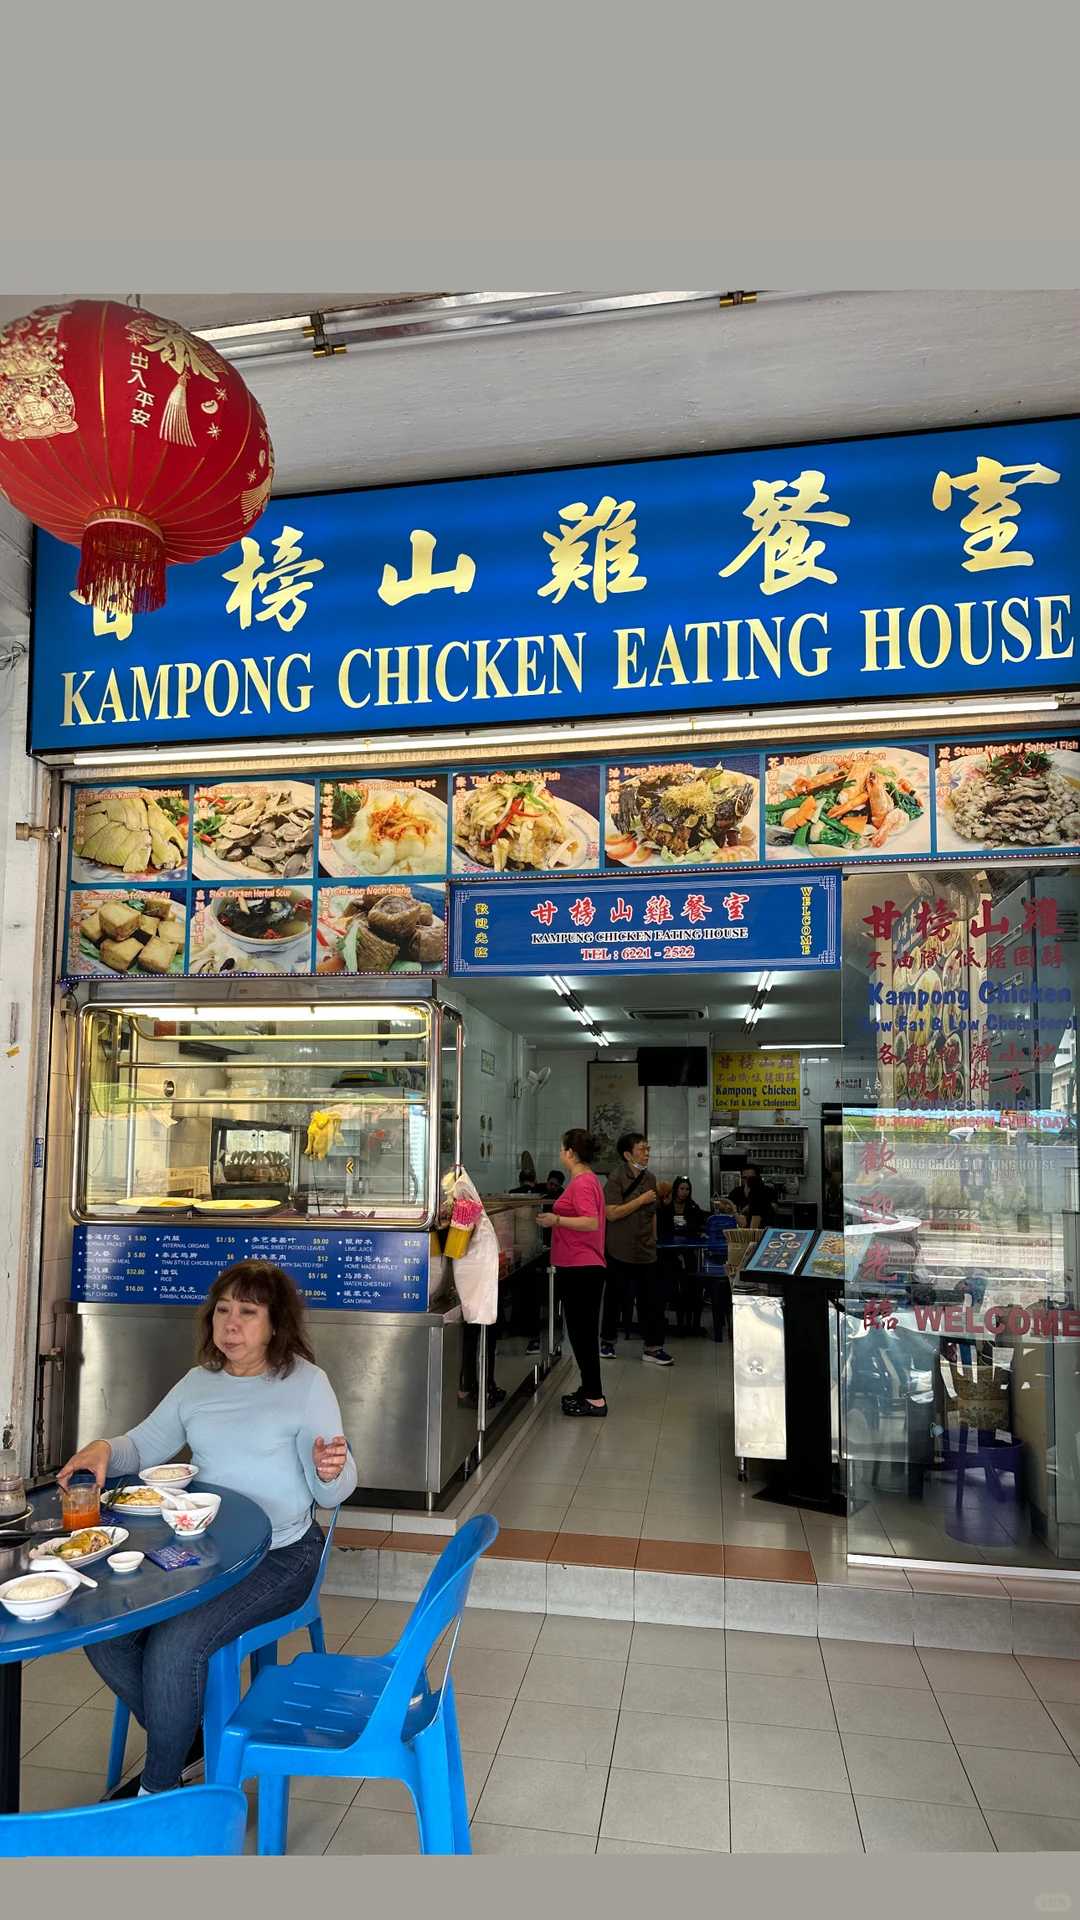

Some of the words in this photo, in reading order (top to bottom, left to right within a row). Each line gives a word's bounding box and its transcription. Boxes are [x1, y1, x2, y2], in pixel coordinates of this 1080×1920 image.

[127, 352, 155, 428] 出入平安
[60, 653, 314, 727] KAMPONG
[338, 631, 587, 710] CHICKEN
[613, 612, 832, 690] EATING
[860, 594, 1075, 672] HOUSE
[954, 746, 983, 757] Steam
[985, 745, 1010, 755] Meat
[1025, 742, 1057, 753] Salted
[1059, 740, 1079, 750] Fish
[783, 756, 809, 766] Fried
[623, 767, 647, 777] Deep
[649, 765, 674, 775] Fried
[675, 763, 694, 773] Fish
[338, 782, 357, 791] Thai
[357, 782, 380, 791] Style
[382, 781, 414, 791] Chicken
[415, 779, 437, 789] Feet
[470, 775, 488, 785] Thai
[490, 774, 513, 784] Style
[515, 772, 542, 783] Sliced
[543, 771, 561, 781] Fish
[211, 787, 241, 796] Chicken
[115, 891, 148, 900] Seafood
[150, 890, 171, 900] Tofu
[228, 890, 253, 899] Chicken
[254, 889, 275, 898] Herbal
[276, 888, 292, 898] Soup
[333, 887, 365, 896] Chicken
[531, 892, 750, 926] 甘榜山雞餐室
[800, 886, 813, 956] WELCOME
[862, 896, 1064, 942] 甘榜山雞
[474, 903, 489, 958] 歡迎光臨
[531, 933, 593, 944] KAMPUNG
[595, 930, 652, 943] CHICKEN
[654, 929, 702, 942] EATING
[703, 927, 749, 940] HOUSE
[581, 949, 610, 960] TEL
[621, 947, 651, 960] 6221
[663, 946, 695, 959] 2522
[868, 981, 970, 1011] Kampong
[979, 980, 1072, 1005] Chicken
[862, 1017, 893, 1032] Low
[899, 1016, 925, 1031] Fat
[931, 1017, 943, 1031] &
[950, 1016, 980, 1031] Low
[985, 1014, 1078, 1031] Cholesterol
[718, 1054, 795, 1070] 甘榜山雞
[716, 1085, 757, 1097] Kampong
[762, 1084, 796, 1095] Chicken
[763, 1098, 796, 1106] Cholesterol
[897, 1100, 975, 1111] BUSINESS
[872, 1115, 926, 1128] 10.30AM
[942, 1116, 996, 1129] 10.00PM
[1000, 1116, 1070, 1130] EVERYDAY
[1019, 1159, 1056, 1170] HOUSE
[895, 1209, 933, 1220] 6221
[938, 1209, 980, 1220] 2522
[859, 1138, 900, 1331] 歡迎光臨
[913, 1305, 1080, 1337] WELCOME
